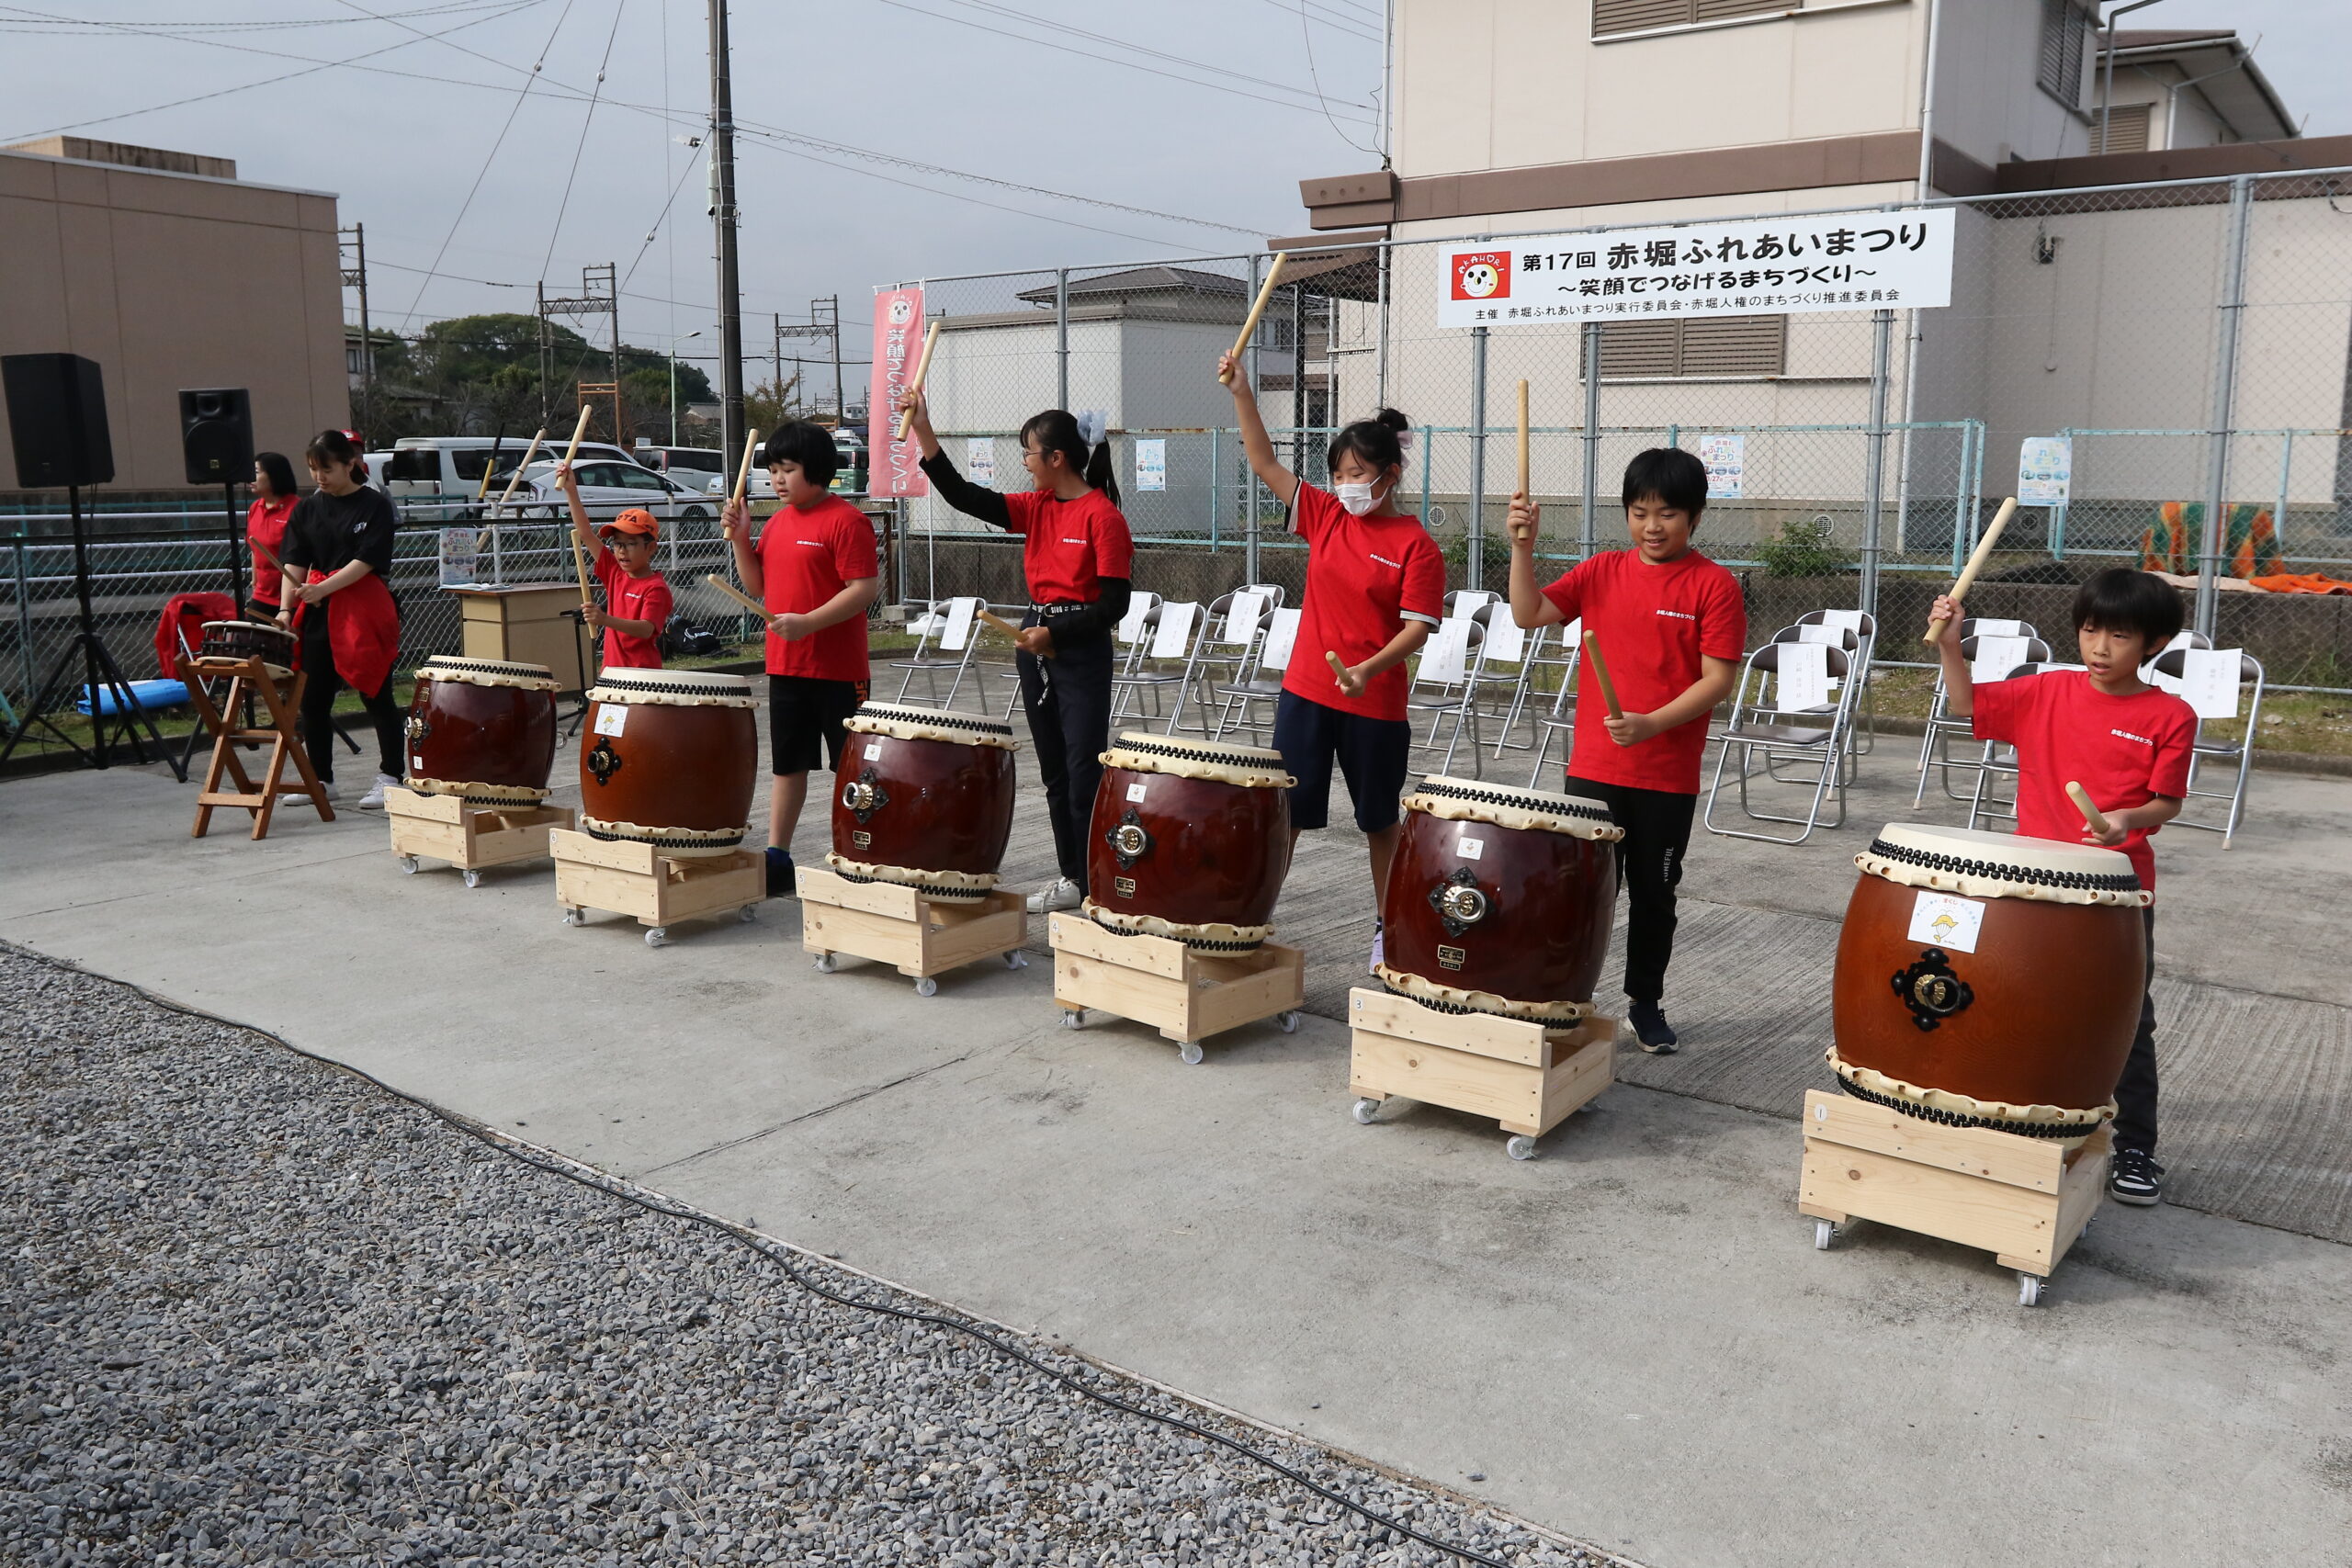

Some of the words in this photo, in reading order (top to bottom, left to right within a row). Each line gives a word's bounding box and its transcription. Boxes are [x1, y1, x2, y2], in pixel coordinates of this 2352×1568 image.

[1522, 252, 1596, 272] 第17回
[1607, 222, 1928, 270] 赤堀ふれあいまつり
[1458, 254, 1505, 275] AKAHORI
[1475, 309, 1499, 321] 主催
[1508, 288, 1901, 319] 赤堀ふれあいまつり実行委員会・赤堀人権のまちづくり推進委員会
